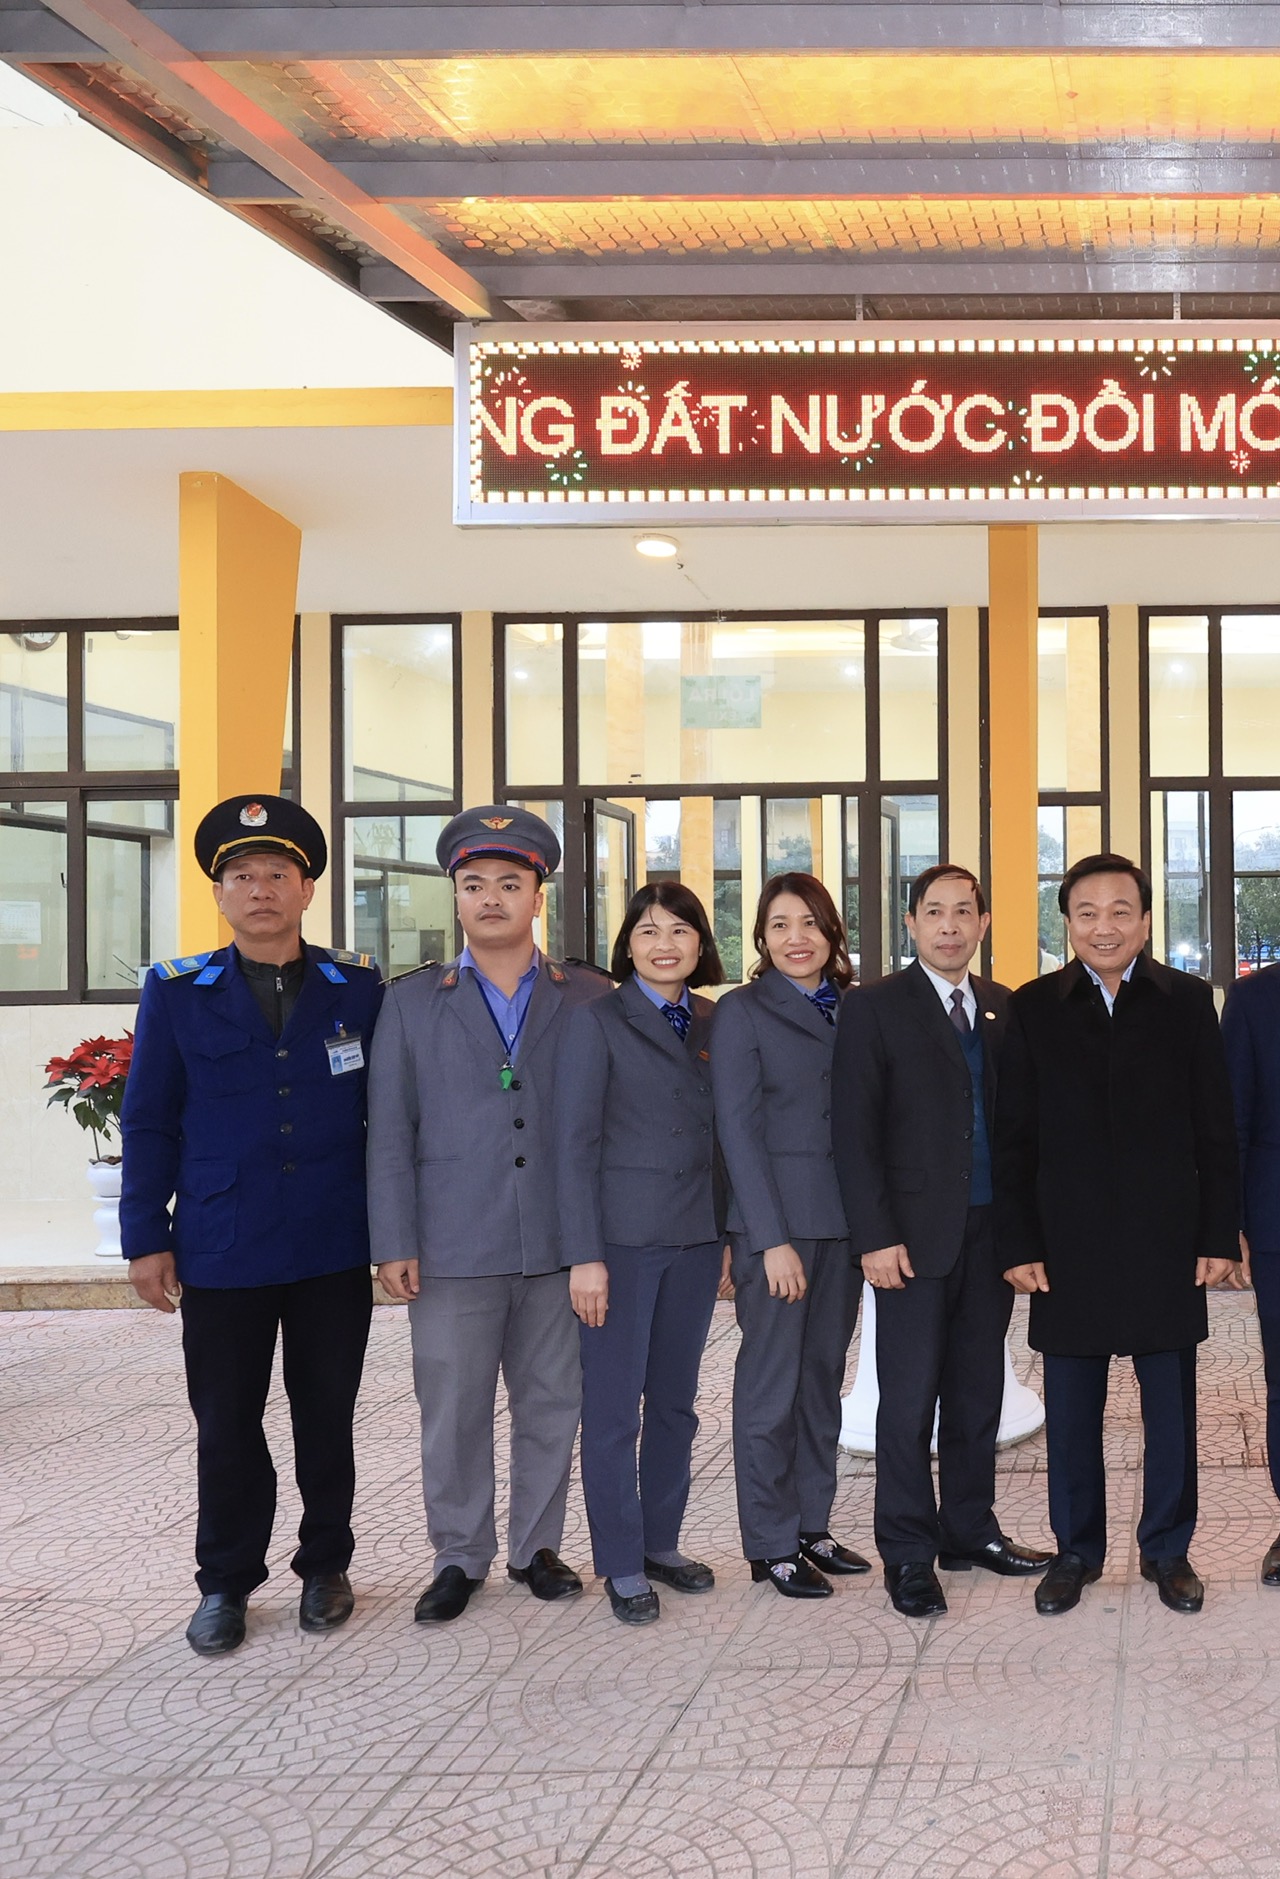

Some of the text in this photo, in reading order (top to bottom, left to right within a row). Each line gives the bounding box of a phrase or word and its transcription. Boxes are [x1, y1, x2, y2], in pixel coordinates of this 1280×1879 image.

[595, 380, 748, 456] ĐẤT
[770, 379, 1006, 455] NƯỚC
[1026, 378, 1155, 454] ĐỔI
